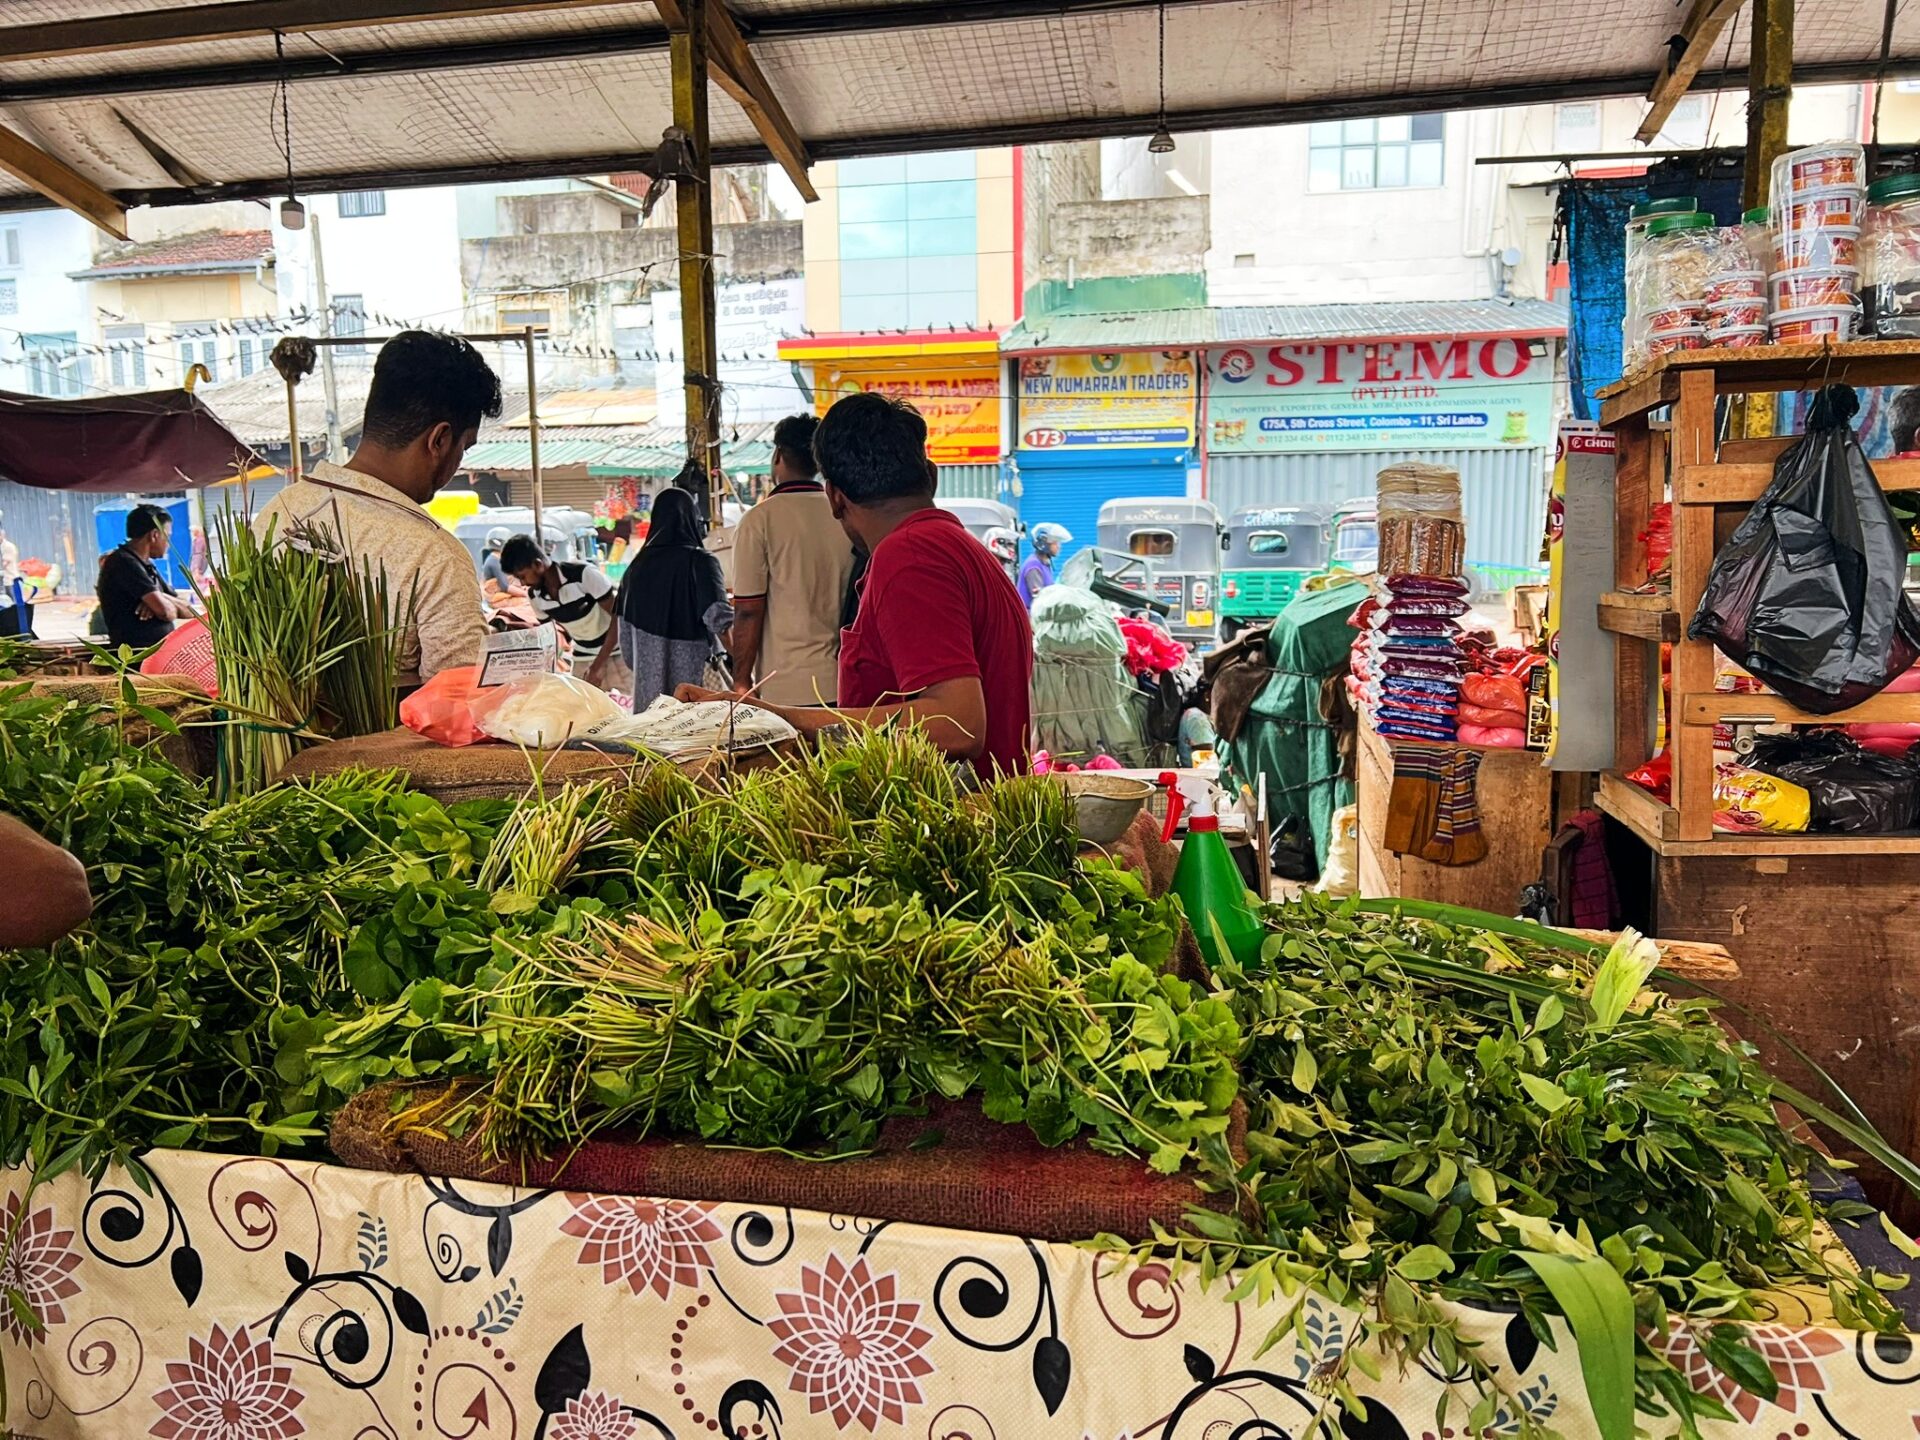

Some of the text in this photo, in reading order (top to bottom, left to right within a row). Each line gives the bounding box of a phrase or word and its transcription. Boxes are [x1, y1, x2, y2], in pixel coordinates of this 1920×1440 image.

[1266, 339, 1531, 386] STEMO
[1025, 374, 1189, 393] NEW KUMARRAN TRADERS
[1351, 385, 1439, 401] (PVT) LTD.
[945, 404, 972, 415] LTD
[1490, 398, 1522, 406] AGENTS
[1263, 419, 1288, 431] 175A,
[1291, 418, 1306, 429] 5th
[1308, 418, 1336, 428] Cross
[1337, 416, 1368, 429] Street,
[1370, 416, 1411, 427] Colombo
[1420, 415, 1435, 427] 11,
[1437, 415, 1450, 426] Sri
[1452, 414, 1486, 426] Lanka.
[1029, 430, 1061, 446] 173
[1584, 438, 1616, 449] CHOIC
